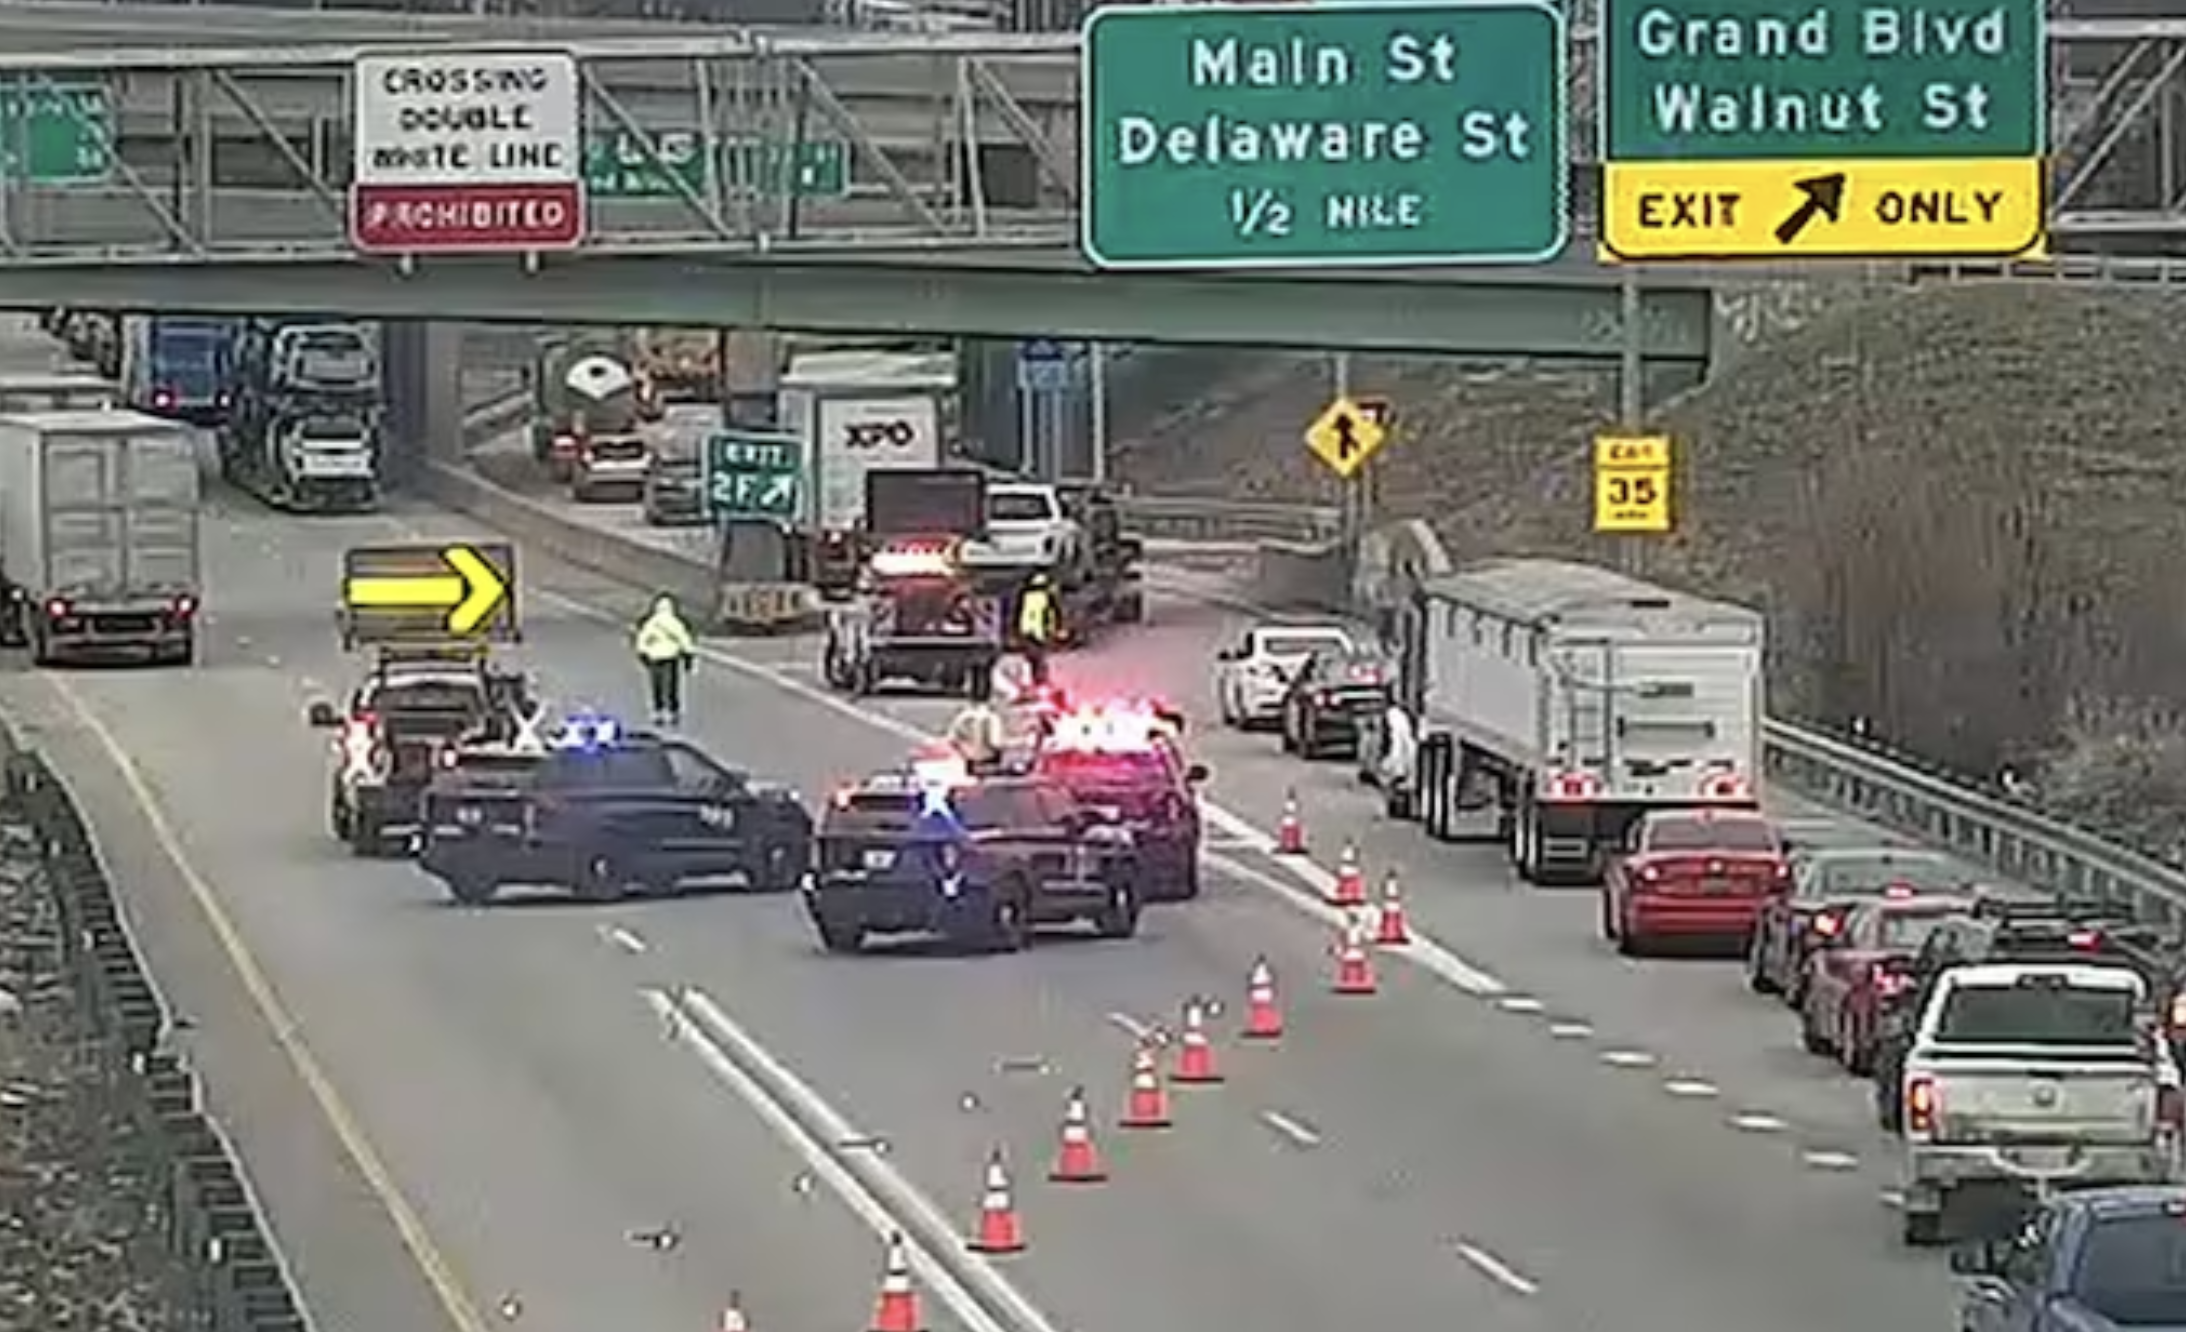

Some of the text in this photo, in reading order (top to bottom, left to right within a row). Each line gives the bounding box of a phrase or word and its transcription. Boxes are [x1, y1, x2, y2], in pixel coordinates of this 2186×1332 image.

[1638, 8, 2002, 56] Grand Blvd
[1193, 33, 1456, 86] Main St
[383, 68, 548, 95] CROSSING
[400, 104, 533, 132] DOUBLE
[1655, 82, 1989, 132] Walnut St
[1118, 110, 1530, 164] Delaware St
[489, 142, 563, 168] LINE
[364, 201, 565, 228] PROHIBITED
[1638, 192, 2003, 228] EXIT ONLY
[844, 420, 914, 449] XPO
[713, 469, 758, 507] 2F
[1608, 478, 1658, 504] 35
